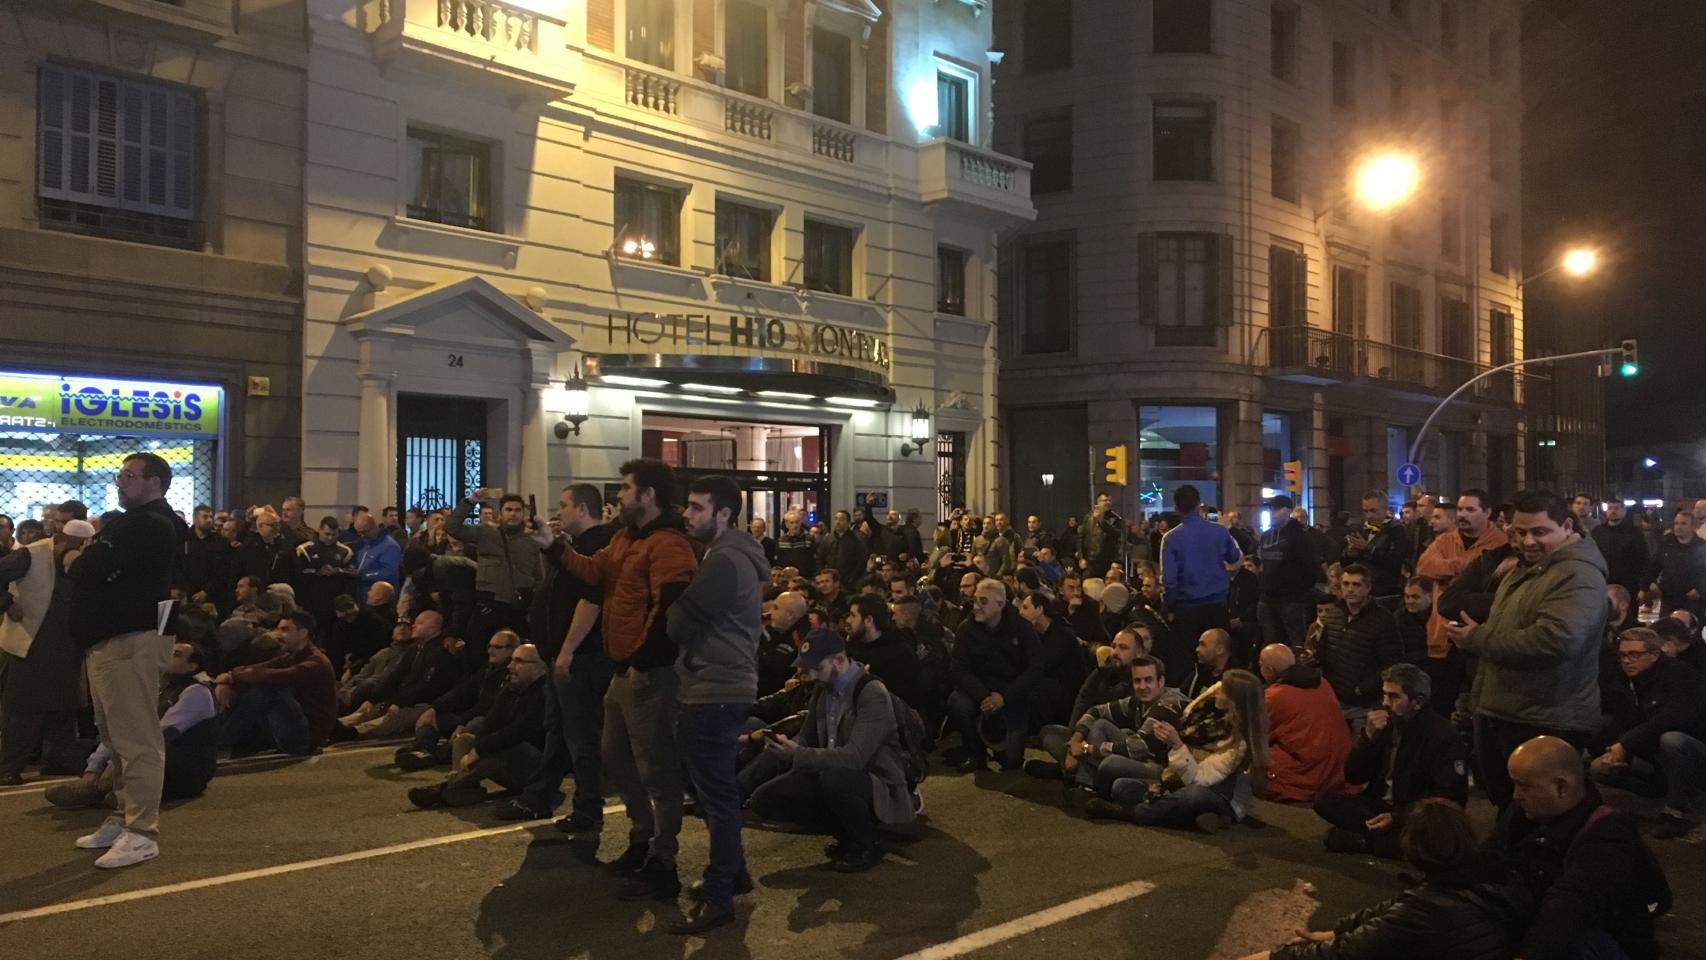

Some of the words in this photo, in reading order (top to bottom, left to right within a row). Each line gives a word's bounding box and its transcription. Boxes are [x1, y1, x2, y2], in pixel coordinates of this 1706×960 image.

[608, 312, 720, 346] HOTEL
[730, 316, 785, 348] H10
[794, 320, 889, 370] MONT
[448, 353, 464, 368] 24
